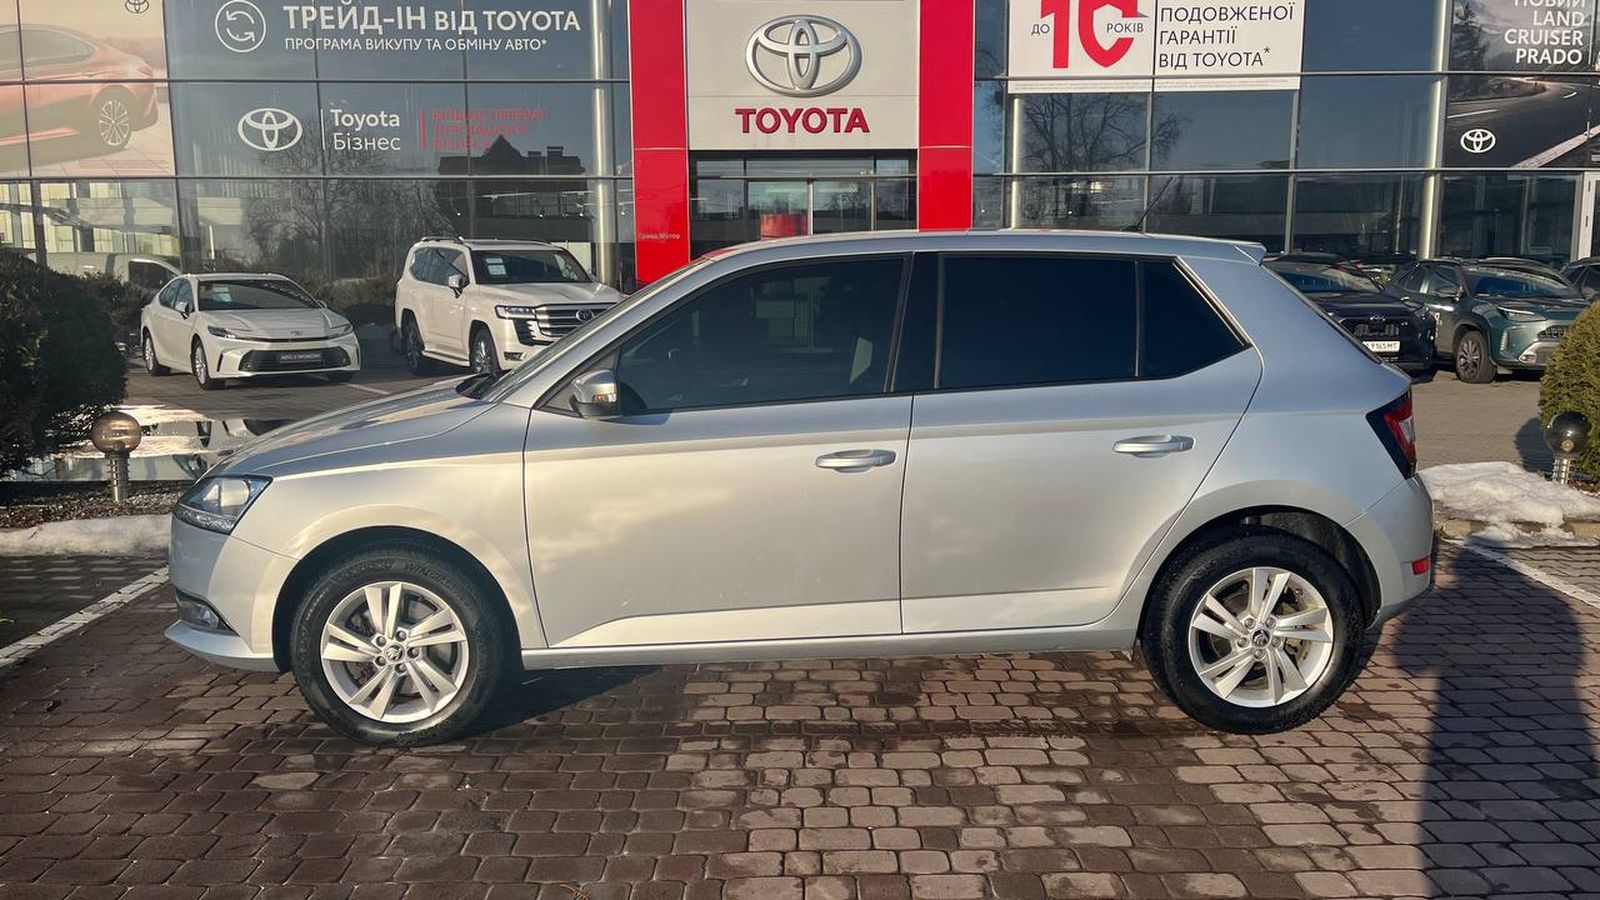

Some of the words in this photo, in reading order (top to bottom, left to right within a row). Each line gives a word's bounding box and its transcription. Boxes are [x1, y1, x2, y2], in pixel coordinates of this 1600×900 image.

[283, 0, 426, 35] ТРЕЙД-ІН
[434, 10, 478, 35] ВІД
[482, 10, 581, 31] TOYOTA
[1160, 1, 1296, 24] ПОДОВЖЕНОЇ
[1533, 10, 1585, 26] LAND
[1031, 23, 1050, 35] ДО
[1106, 22, 1144, 33] РОКІВ
[1159, 25, 1238, 45] ГАРАНТІЇ
[1504, 28, 1583, 46] CRUISER
[284, 37, 362, 50] ПРОГРАМА
[365, 38, 423, 51] ВИКУПУ
[425, 38, 442, 50] ТА
[445, 38, 502, 51] ОБМІНУ
[1159, 52, 1188, 71] ВІД
[1515, 48, 1583, 65] PRADO
[329, 108, 400, 131] Toyota
[735, 107, 870, 134] TOYOTA
[333, 132, 401, 151] Бізнес
